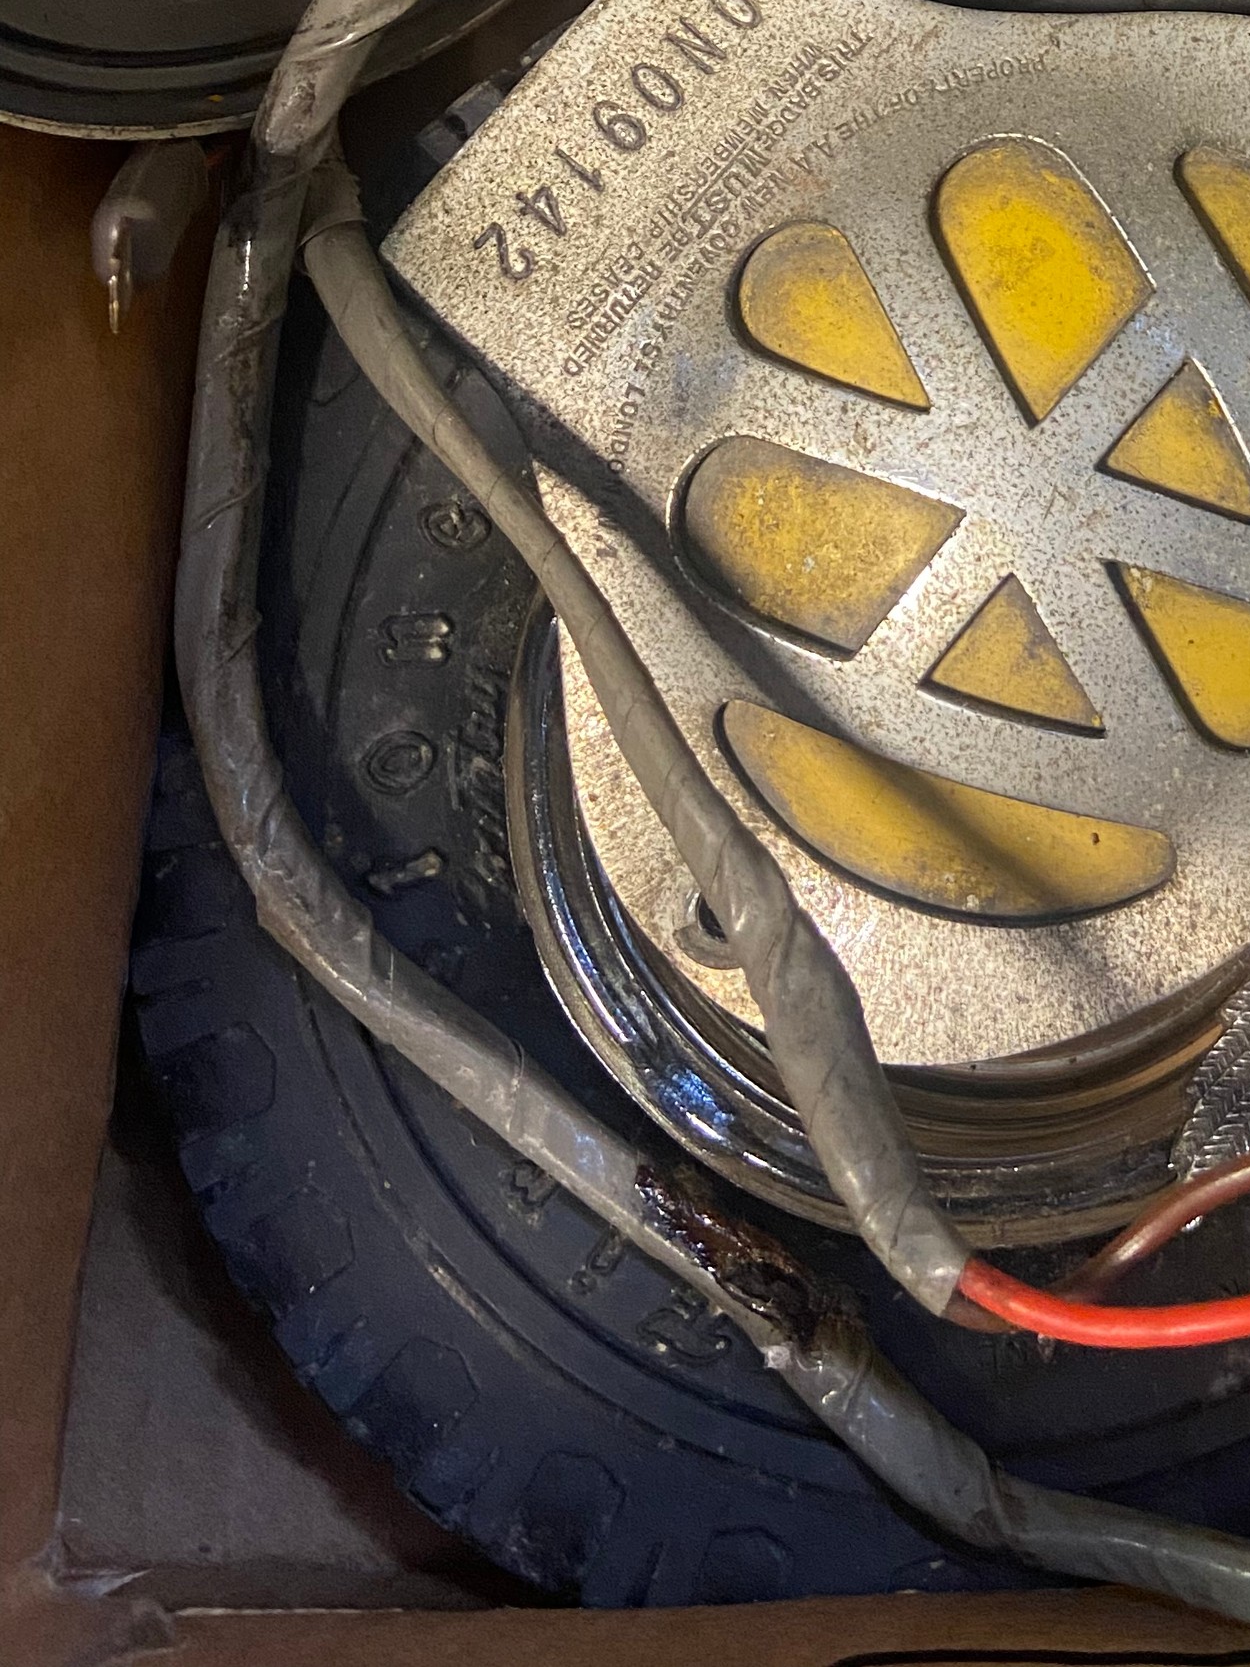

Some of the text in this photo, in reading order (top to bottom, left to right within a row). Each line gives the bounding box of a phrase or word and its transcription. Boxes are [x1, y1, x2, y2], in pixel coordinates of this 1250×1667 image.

[557, 27, 870, 380] THIS BADGE MUST BE RETURNED
[563, 40, 825, 332] WHEN MEMBERSHIP CEASES
[734, 166, 793, 223] NEW
[834, 106, 884, 143] THE
